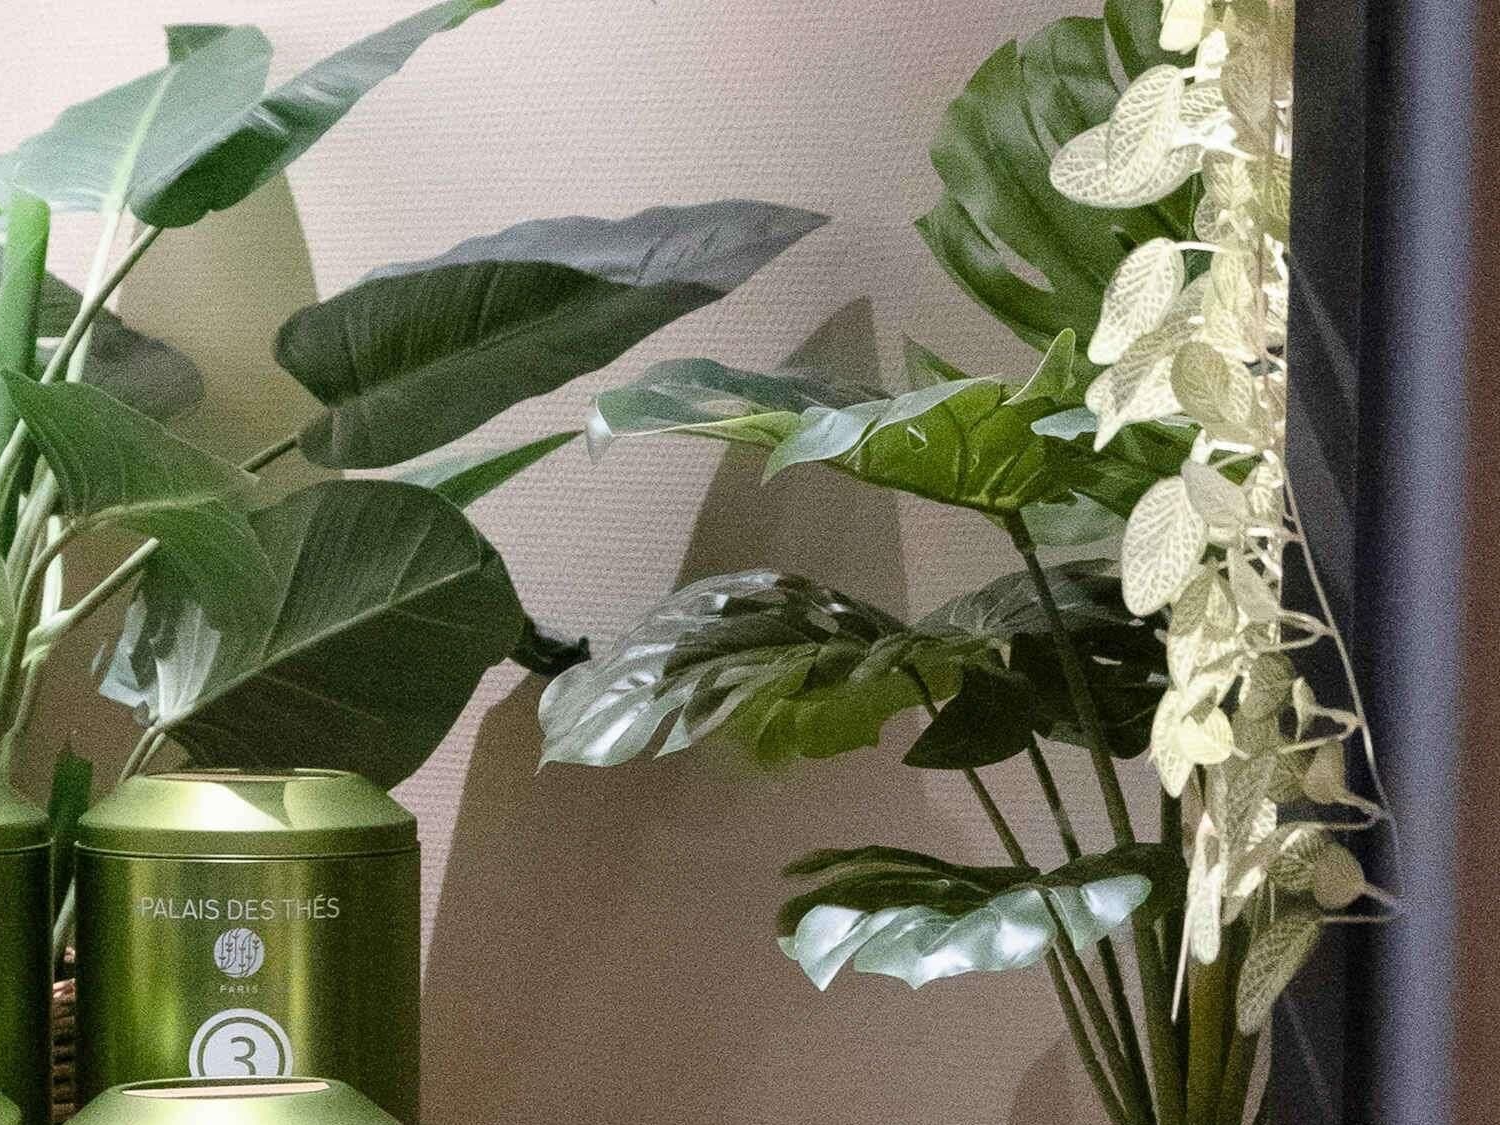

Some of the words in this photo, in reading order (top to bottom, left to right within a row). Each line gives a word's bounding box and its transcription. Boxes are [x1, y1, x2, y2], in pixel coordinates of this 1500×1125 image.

[141, 896, 220, 920] PALAIS
[228, 898, 276, 921] DES
[283, 894, 341, 920] THÉS
[219, 984, 259, 994] PARIS
[230, 1036, 257, 1076] 3
